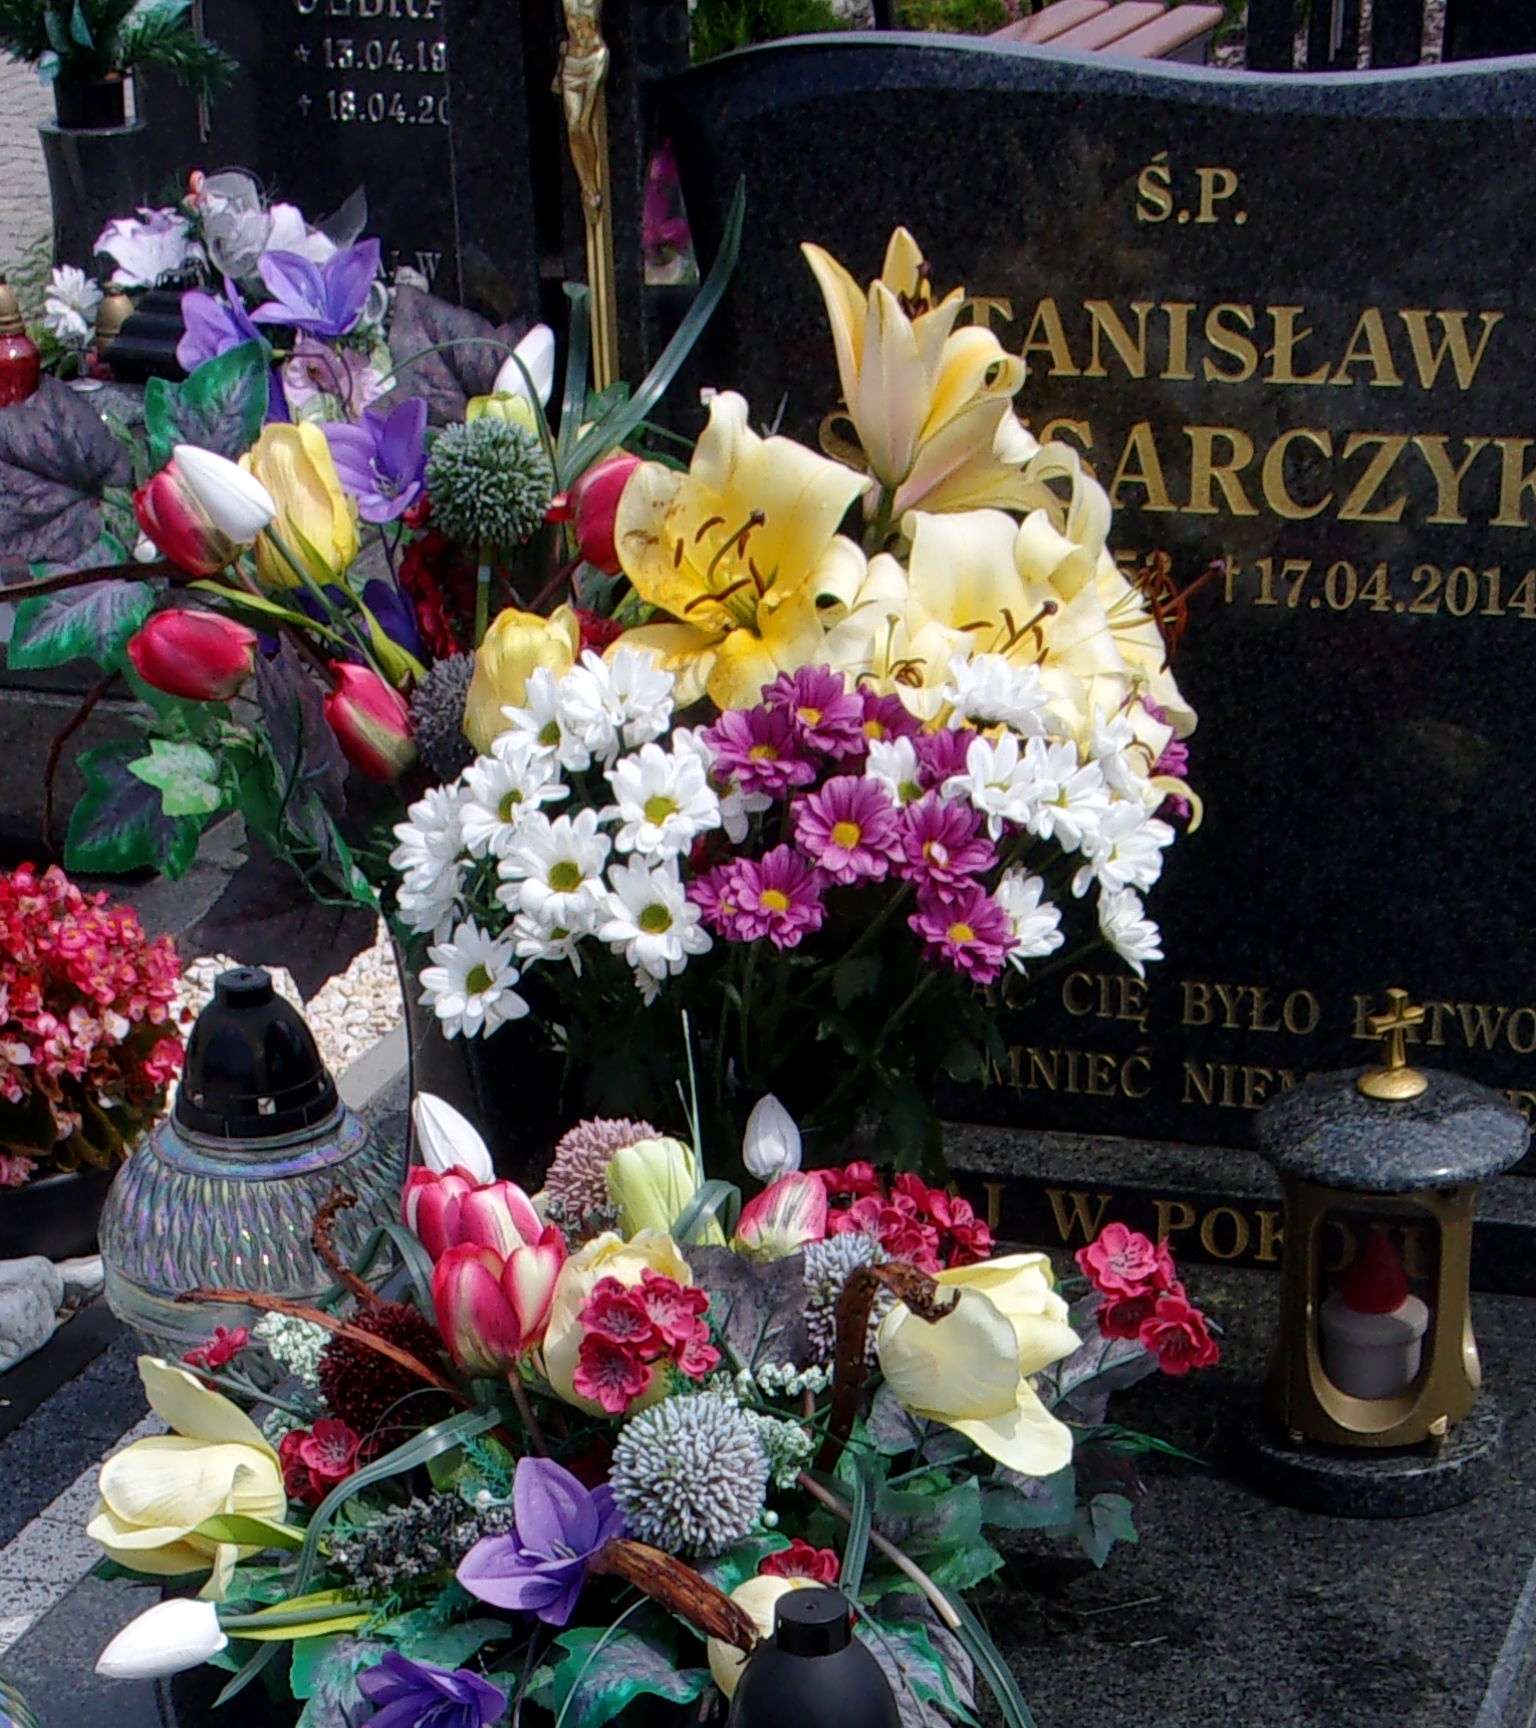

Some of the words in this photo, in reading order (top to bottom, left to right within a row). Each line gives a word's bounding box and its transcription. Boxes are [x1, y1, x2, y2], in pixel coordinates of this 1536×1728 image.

[328, 90, 451, 125] 18.04.20
[1136, 151, 1248, 225] Ś.P.
[964, 294, 1505, 391] TANISŁAW
[1062, 971, 1150, 1033] CIĘ
[1180, 980, 1320, 1035] BYŁO
[949, 1046, 1153, 1099] MNIEĆ
[1045, 1187, 1113, 1243] W
